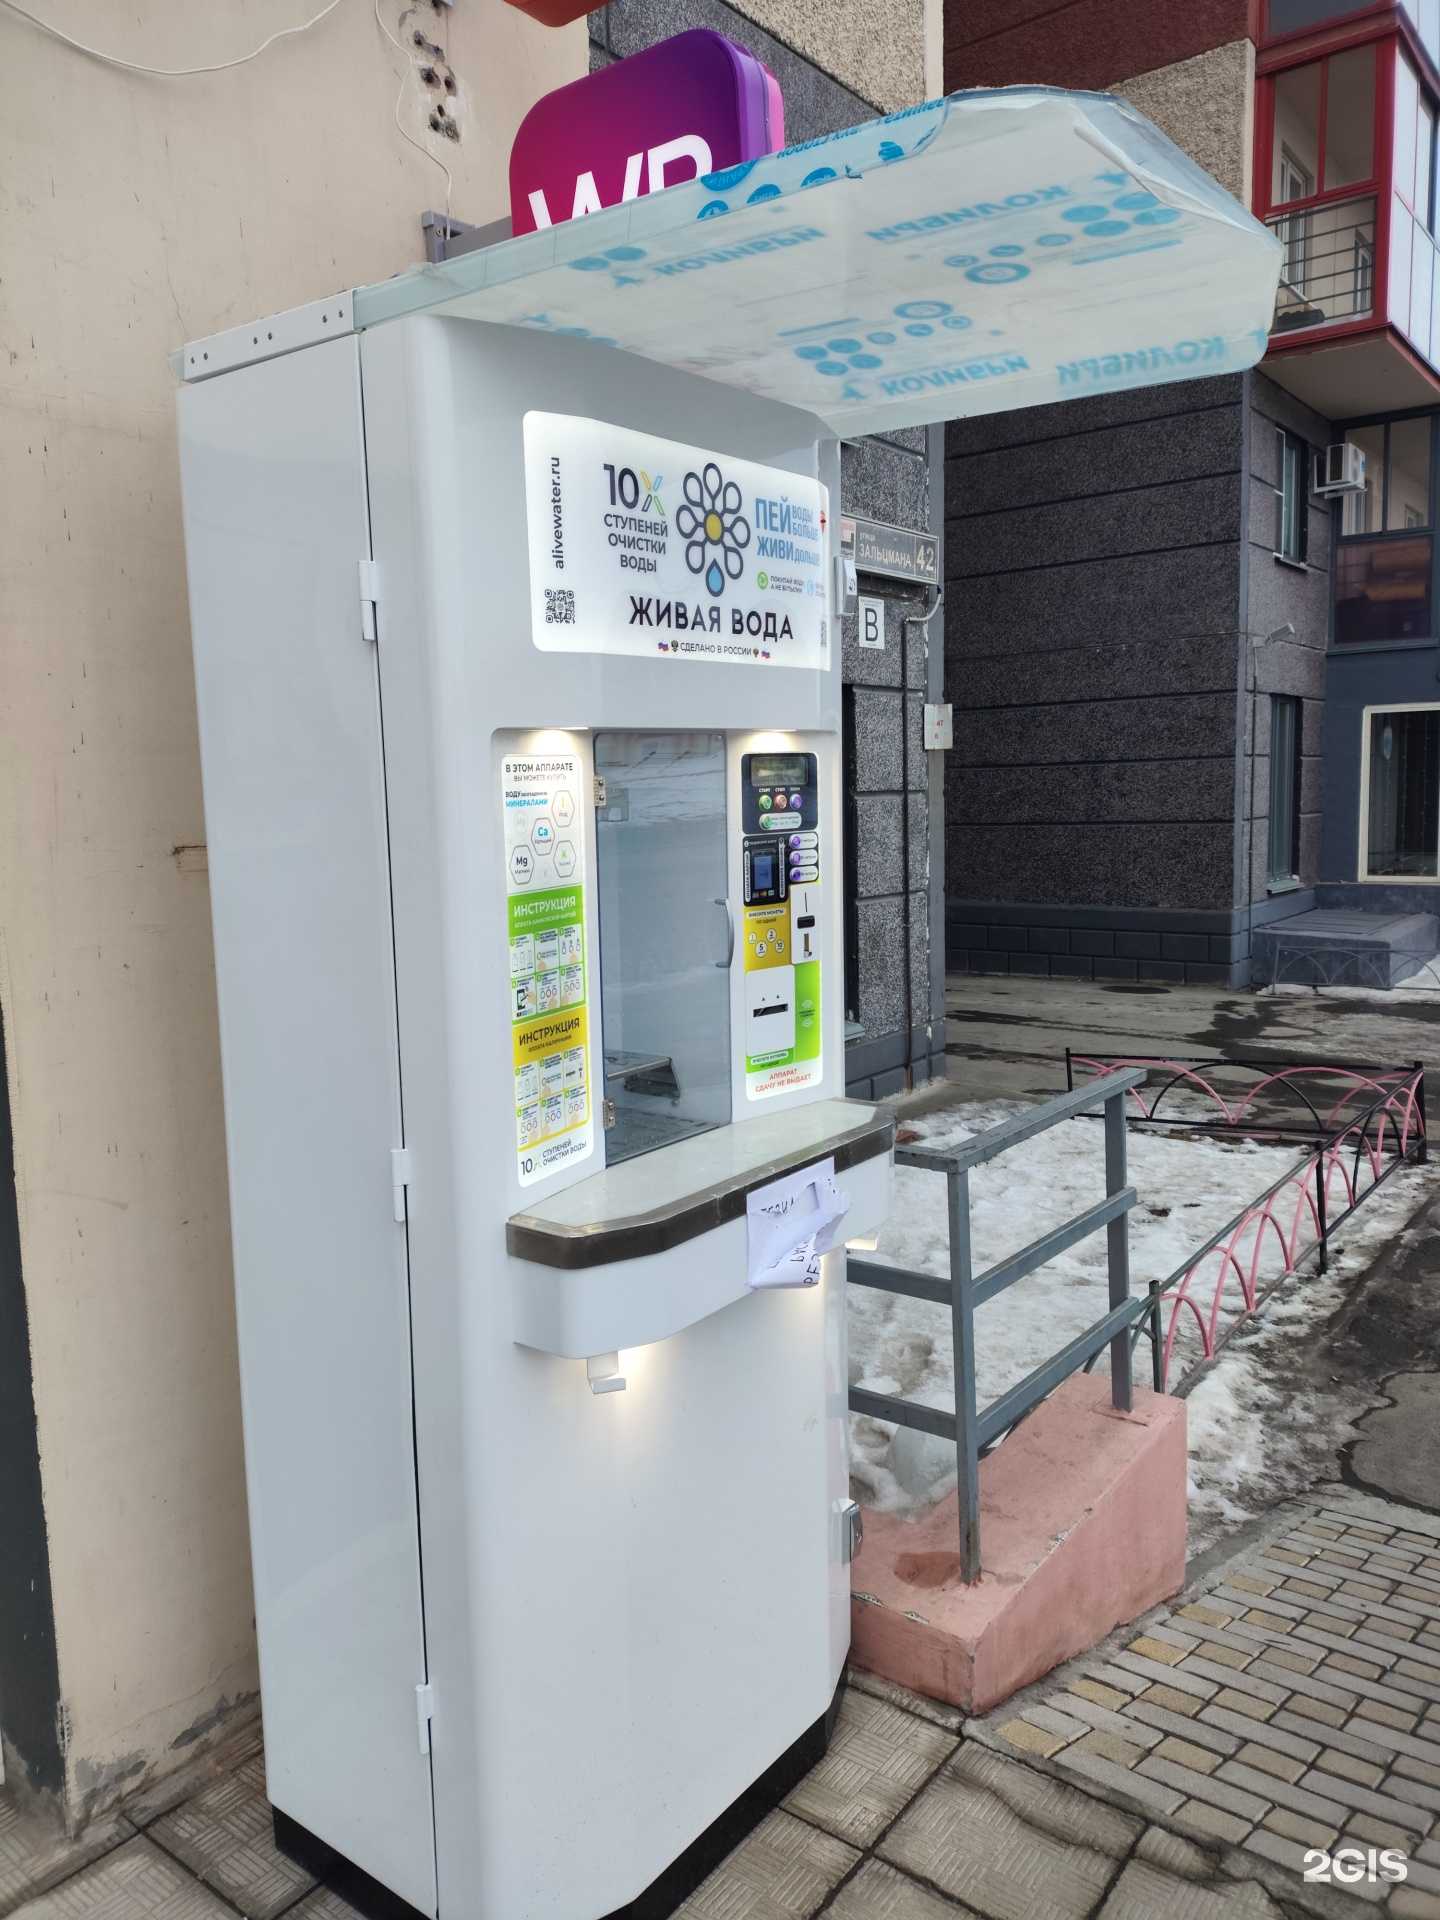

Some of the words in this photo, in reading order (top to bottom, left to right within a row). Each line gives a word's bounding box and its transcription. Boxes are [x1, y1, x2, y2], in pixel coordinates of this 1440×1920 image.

[551, 456, 565, 570] alivewater.ru
[755, 496, 791, 535] ПЕЙ
[603, 513, 669, 538] СТУПЕНЕЙ
[608, 532, 667, 555] ОЧИСТКИ
[757, 535, 794, 560] ЖИВИ
[620, 554, 657, 573] ВОДЫ
[859, 543, 912, 570] ЗАЛЬЦМАНА
[916, 544, 935, 571] 42
[629, 595, 722, 633] ЖИВАЯ
[731, 608, 793, 643] ВОДА
[680, 642, 716, 653] СДЕЛАНО
[717, 644, 722, 653] В
[723, 645, 752, 656] РОССИИ
[505, 763, 511, 773] В
[512, 763, 534, 773] ЭТОМ
[535, 762, 574, 772] АППАРАТЕ
[537, 826, 549, 837] Ca
[516, 856, 528, 867] Mg
[513, 896, 577, 918] ИНСТРУКЦИЯ
[519, 1017, 580, 1046] ИНСТРУКЦИЯ
